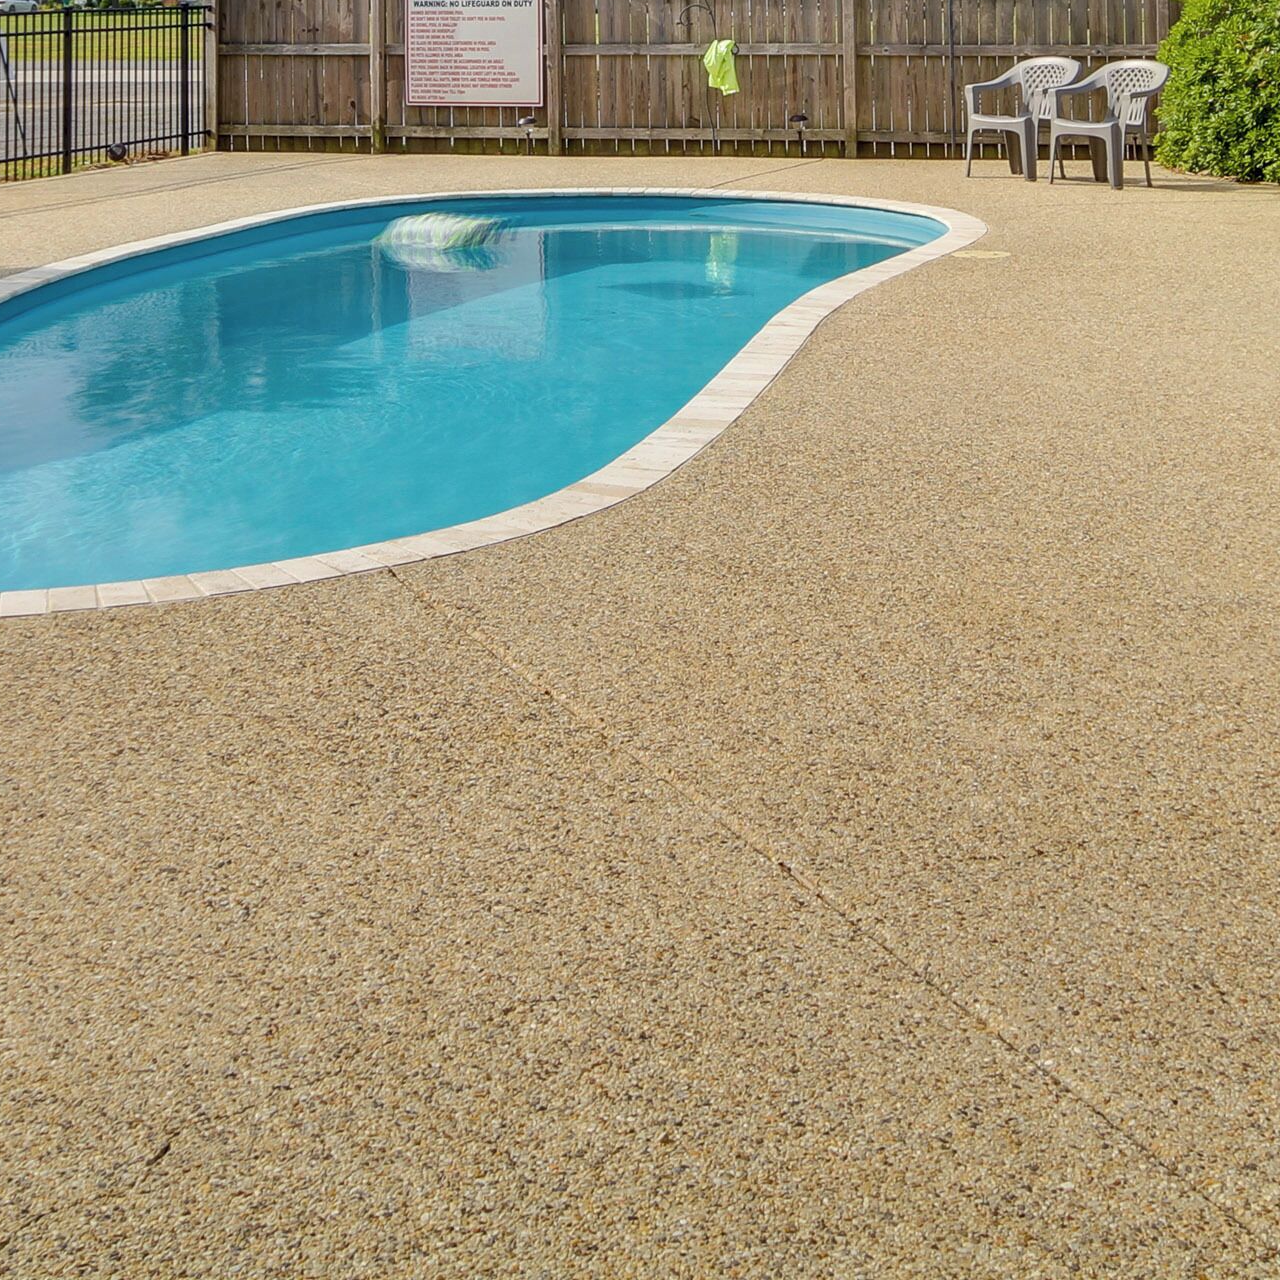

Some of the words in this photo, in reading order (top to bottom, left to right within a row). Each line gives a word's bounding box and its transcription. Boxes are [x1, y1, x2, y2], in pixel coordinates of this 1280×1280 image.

[414, 0, 448, 8] WARNING:
[450, 0, 459, 8] NO
[462, 0, 500, 8] LIFEGUARD
[501, 0, 512, 8] ON
[514, 0, 533, 8] DUTY
